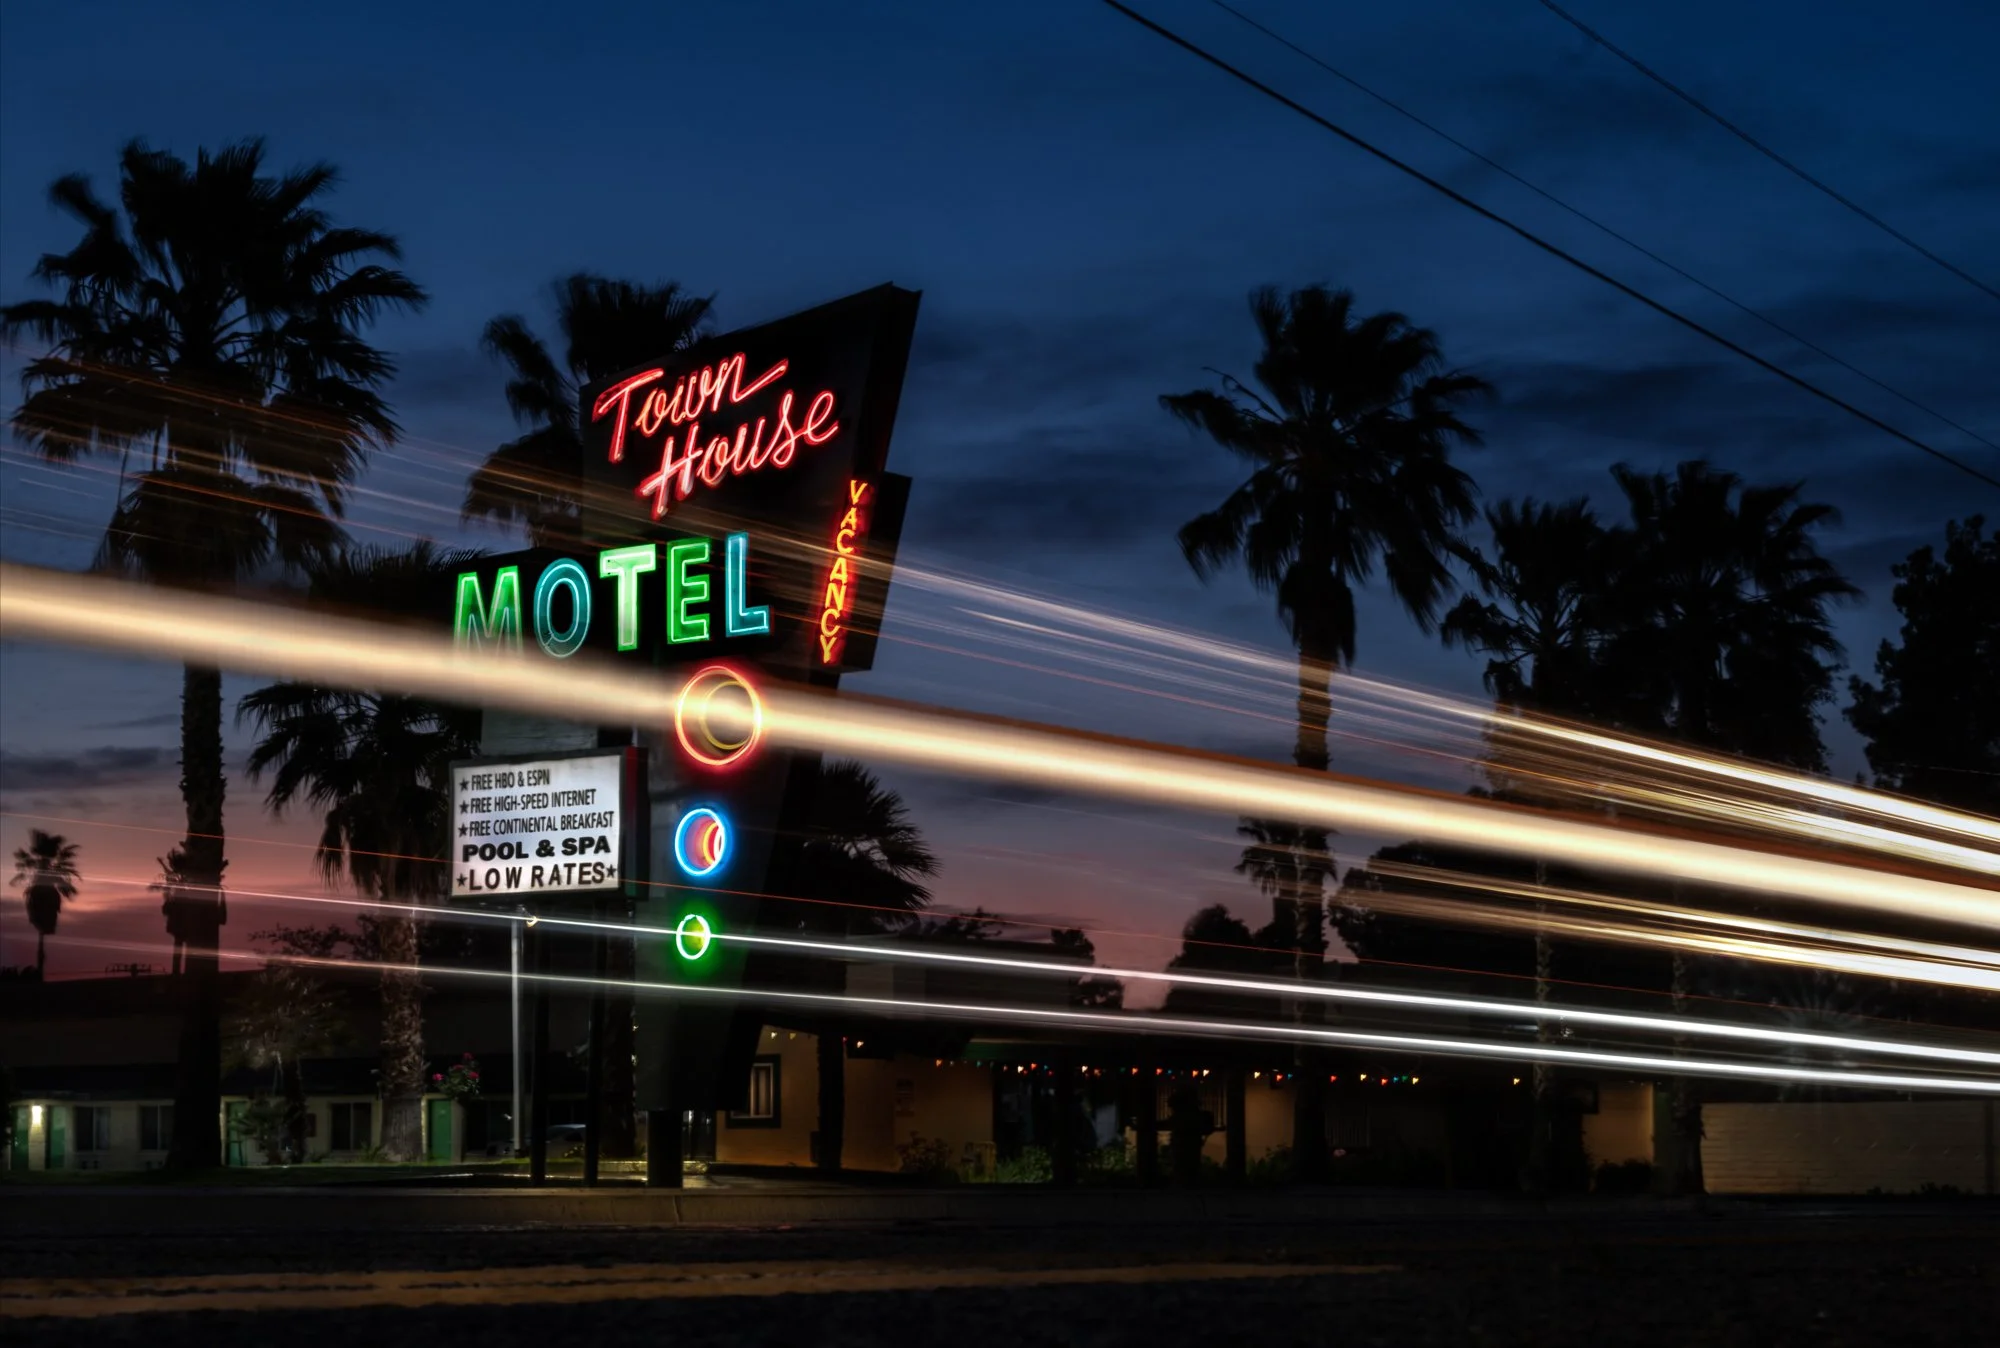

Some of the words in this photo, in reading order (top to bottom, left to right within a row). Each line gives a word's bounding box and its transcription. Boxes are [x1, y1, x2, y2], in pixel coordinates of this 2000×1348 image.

[593, 352, 789, 462] Town
[636, 390, 839, 519] House
[818, 478, 869, 666] VACANCY
[453, 531, 771, 660] MOTEL
[471, 773, 493, 791] FREE
[495, 771, 515, 789] HBO
[518, 771, 525, 786] &
[527, 769, 550, 786] ESPN
[470, 797, 492, 814] FREE
[494, 793, 549, 812] HIGH-SPEED
[551, 789, 597, 808] INTERNET
[469, 820, 491, 837] FREE
[493, 816, 558, 836] CONTINENTAL
[560, 811, 614, 831] BREAKFAST
[462, 841, 529, 863] POOL
[535, 839, 555, 858] &
[561, 835, 611, 857] SPA
[469, 866, 522, 891] LOW
[530, 861, 605, 888] RATES
